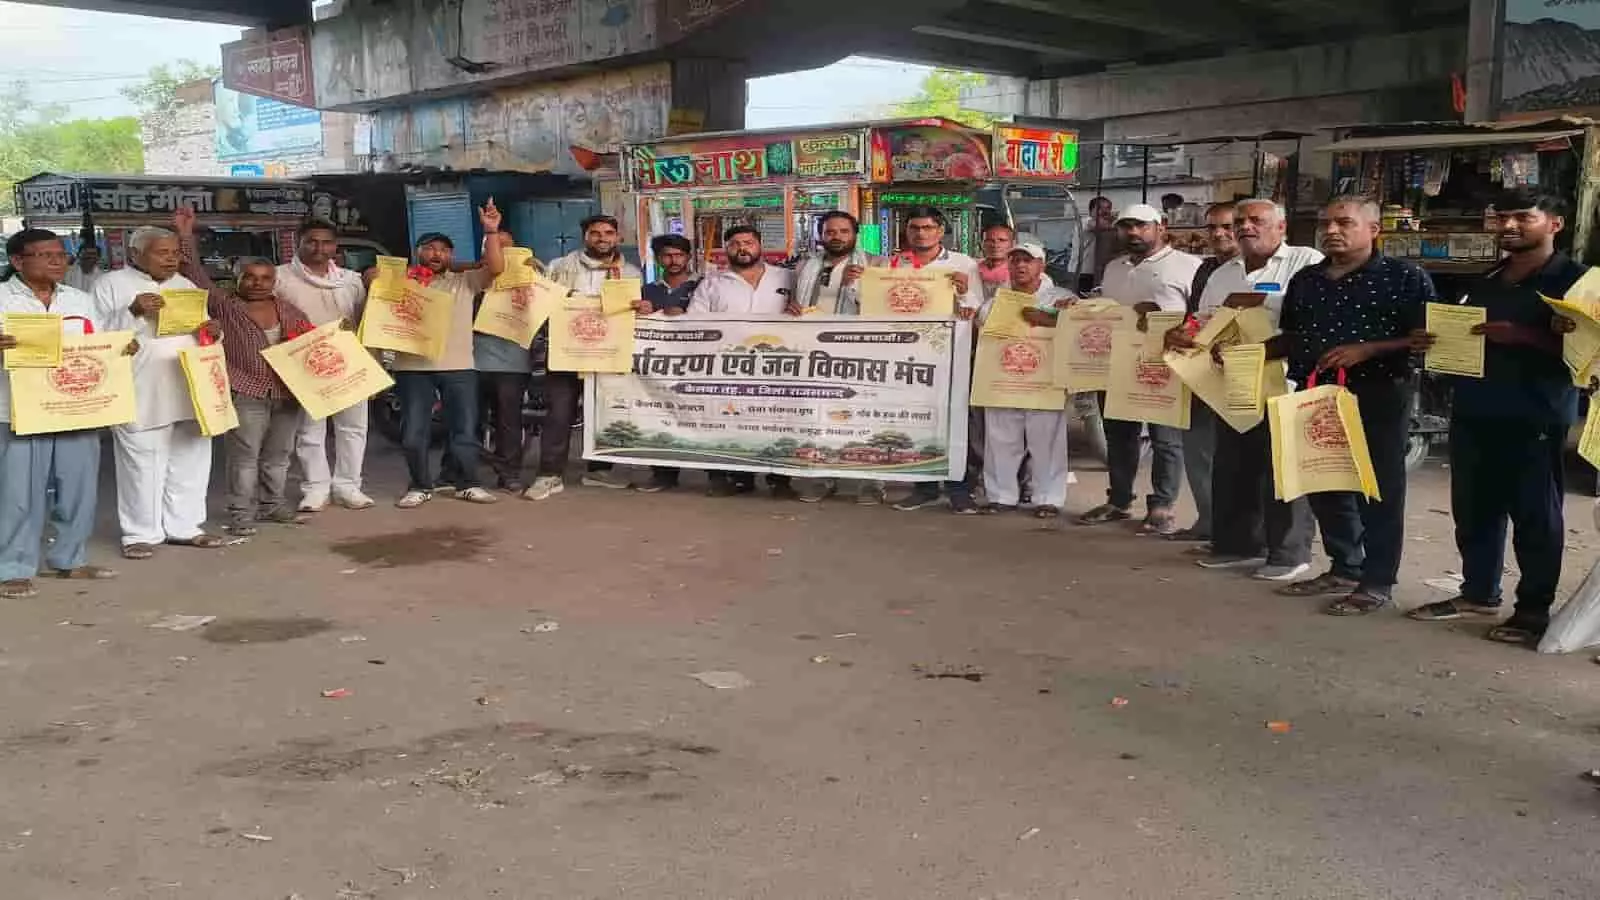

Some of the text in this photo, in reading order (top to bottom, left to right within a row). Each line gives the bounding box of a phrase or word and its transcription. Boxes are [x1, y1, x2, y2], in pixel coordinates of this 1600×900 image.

[721, 349, 757, 376] एवं
[761, 354, 803, 377] जन
[808, 350, 889, 383] विकास
[895, 356, 937, 387] मंच
